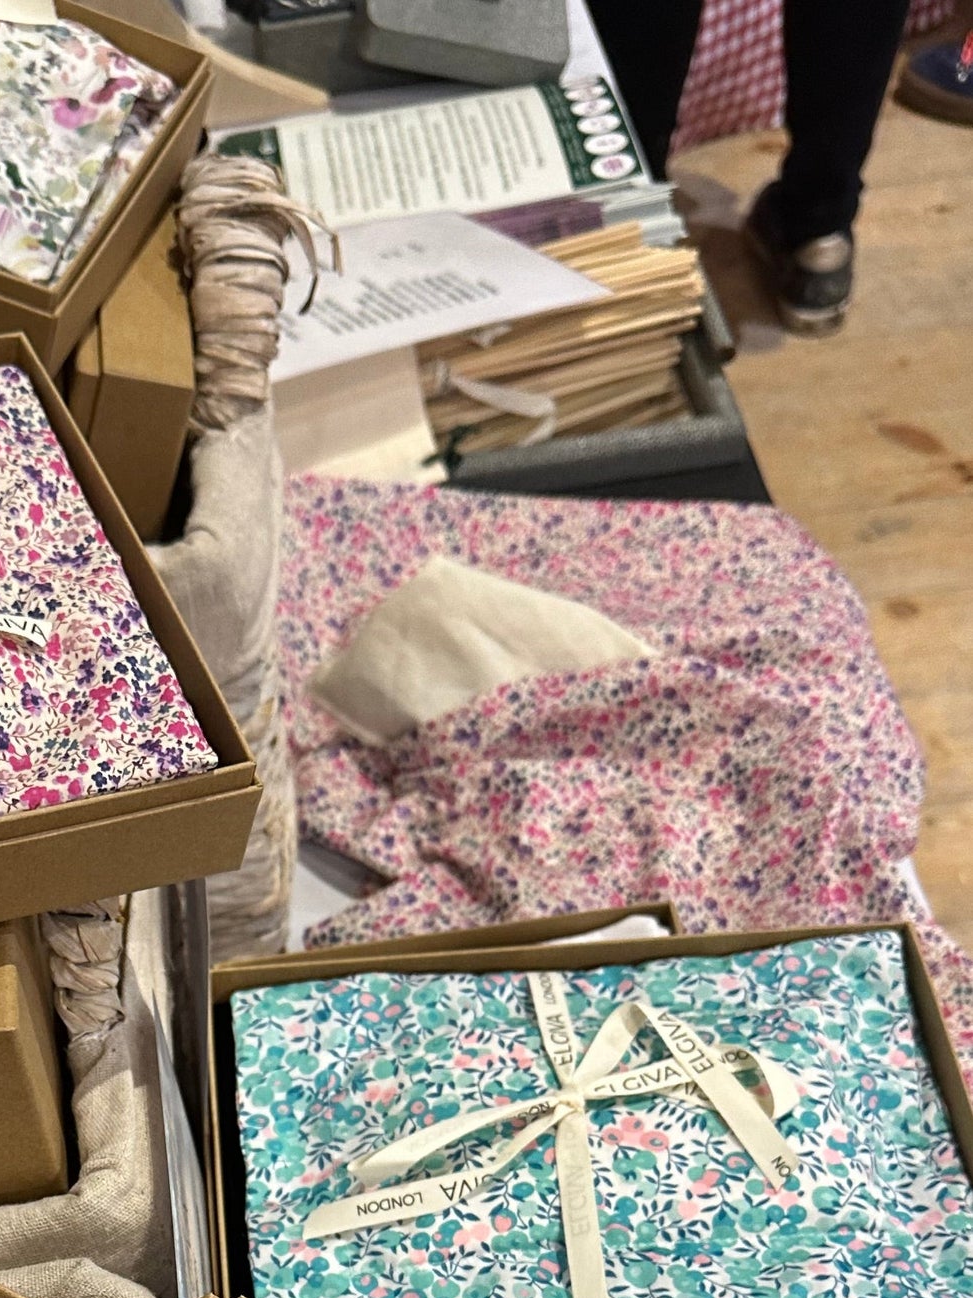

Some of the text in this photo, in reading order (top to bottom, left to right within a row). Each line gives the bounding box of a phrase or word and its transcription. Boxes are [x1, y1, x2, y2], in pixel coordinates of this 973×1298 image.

[545, 1014, 573, 1066] ELGIVA
[657, 1012, 715, 1074] ELGIVA
[356, 1191, 424, 1217] LONDON
